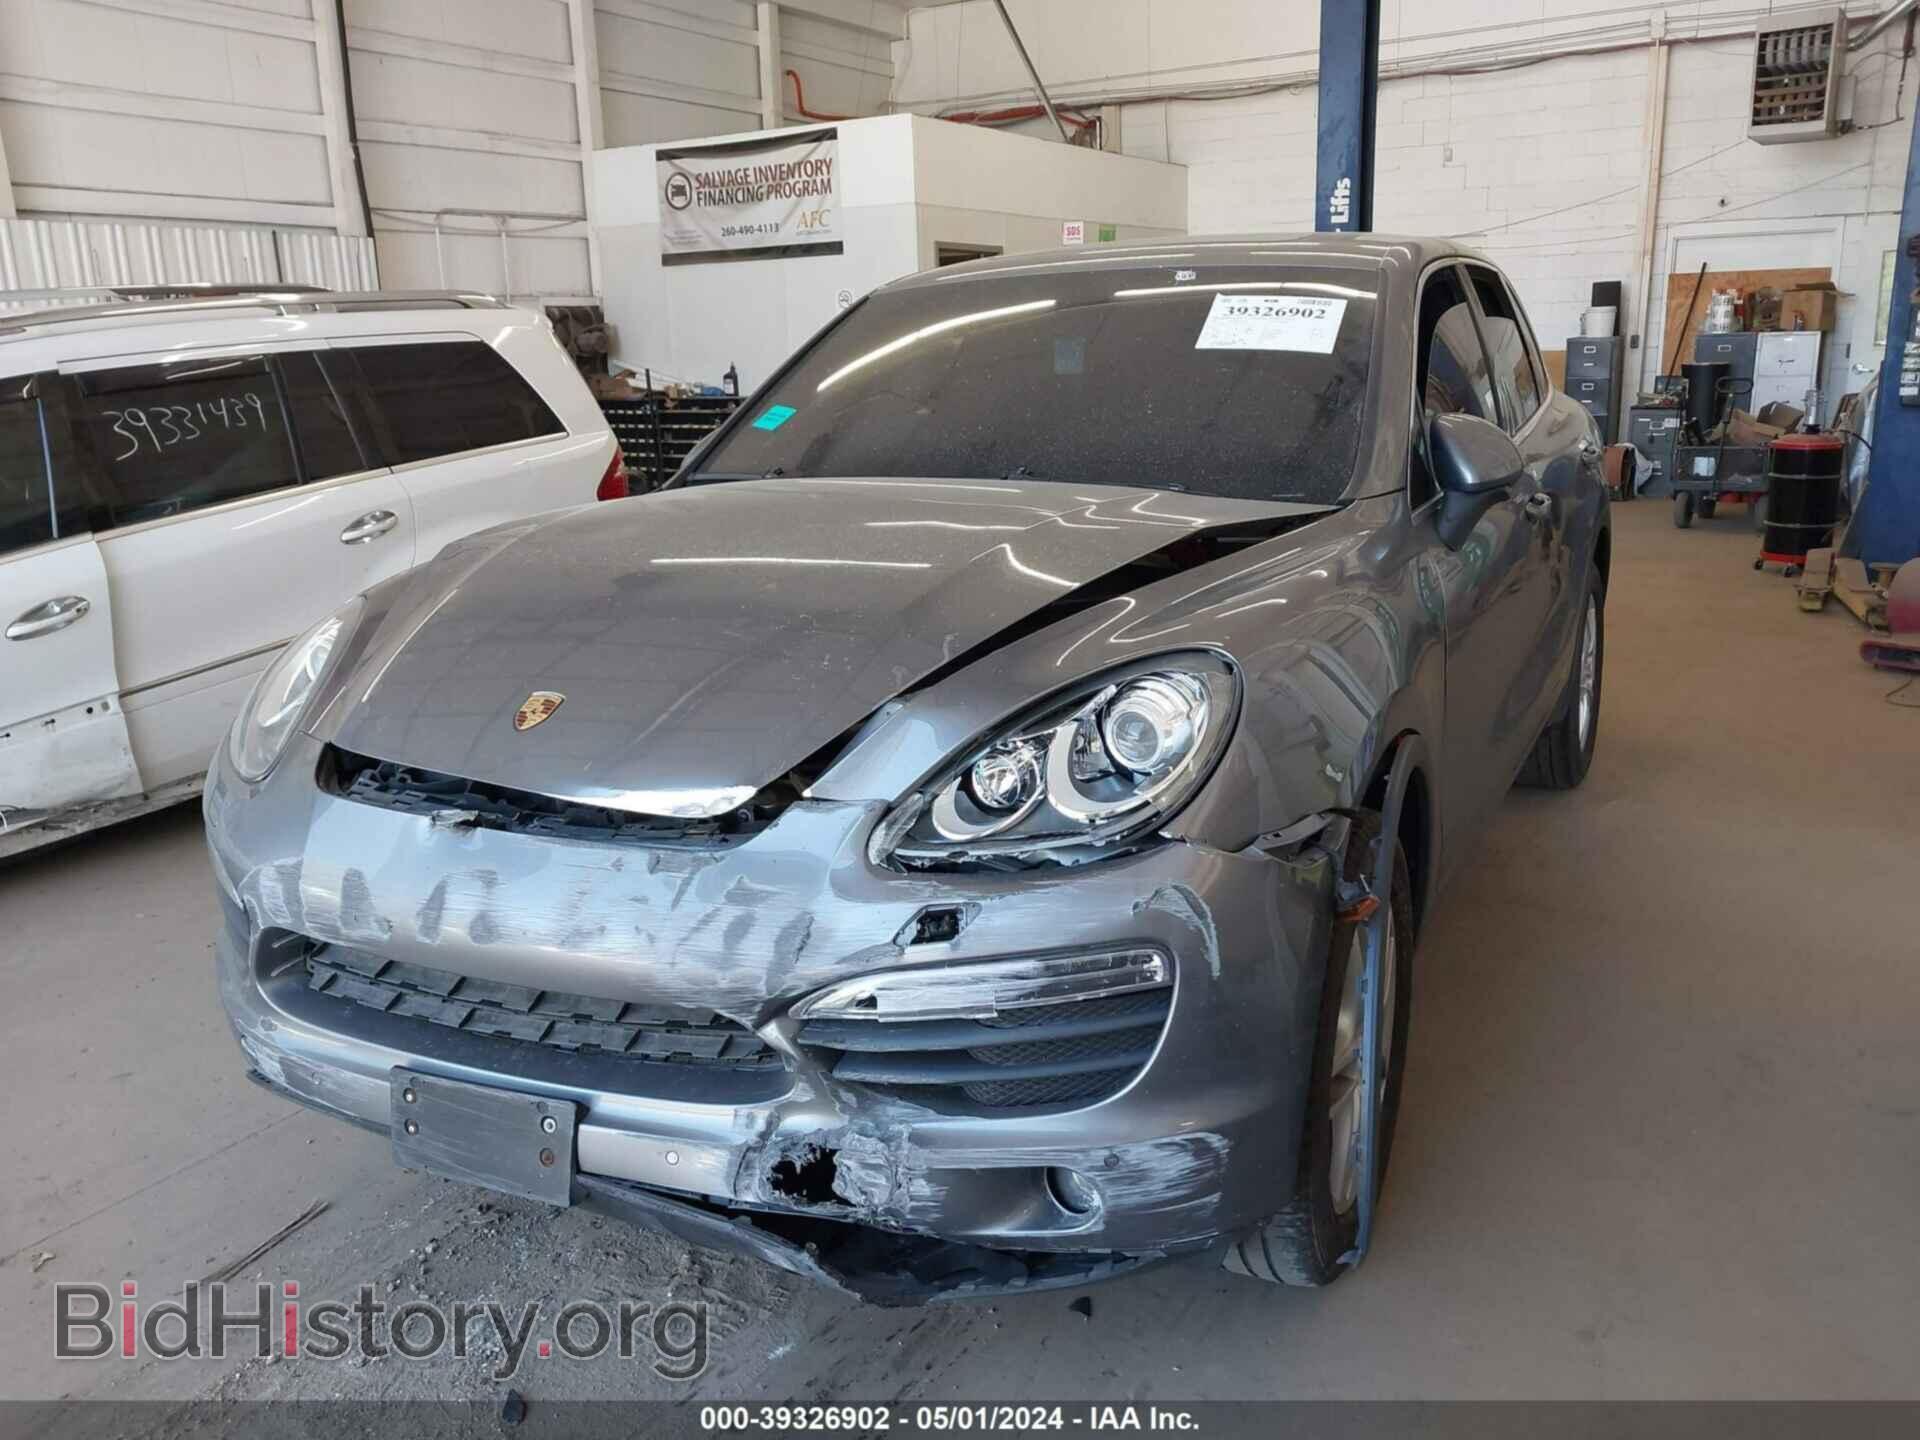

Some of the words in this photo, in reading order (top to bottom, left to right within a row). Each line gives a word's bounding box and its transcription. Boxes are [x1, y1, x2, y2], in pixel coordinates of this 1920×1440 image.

[694, 167, 750, 190] SALVAGE
[753, 158, 833, 182] INVENTORY
[696, 185, 764, 208] FINANCING
[766, 178, 833, 201] PROGRAM
[1330, 177, 1351, 224] Lifts
[796, 208, 832, 230] AFC
[1223, 305, 1327, 319] 39326902
[102, 392, 267, 461] 39331439
